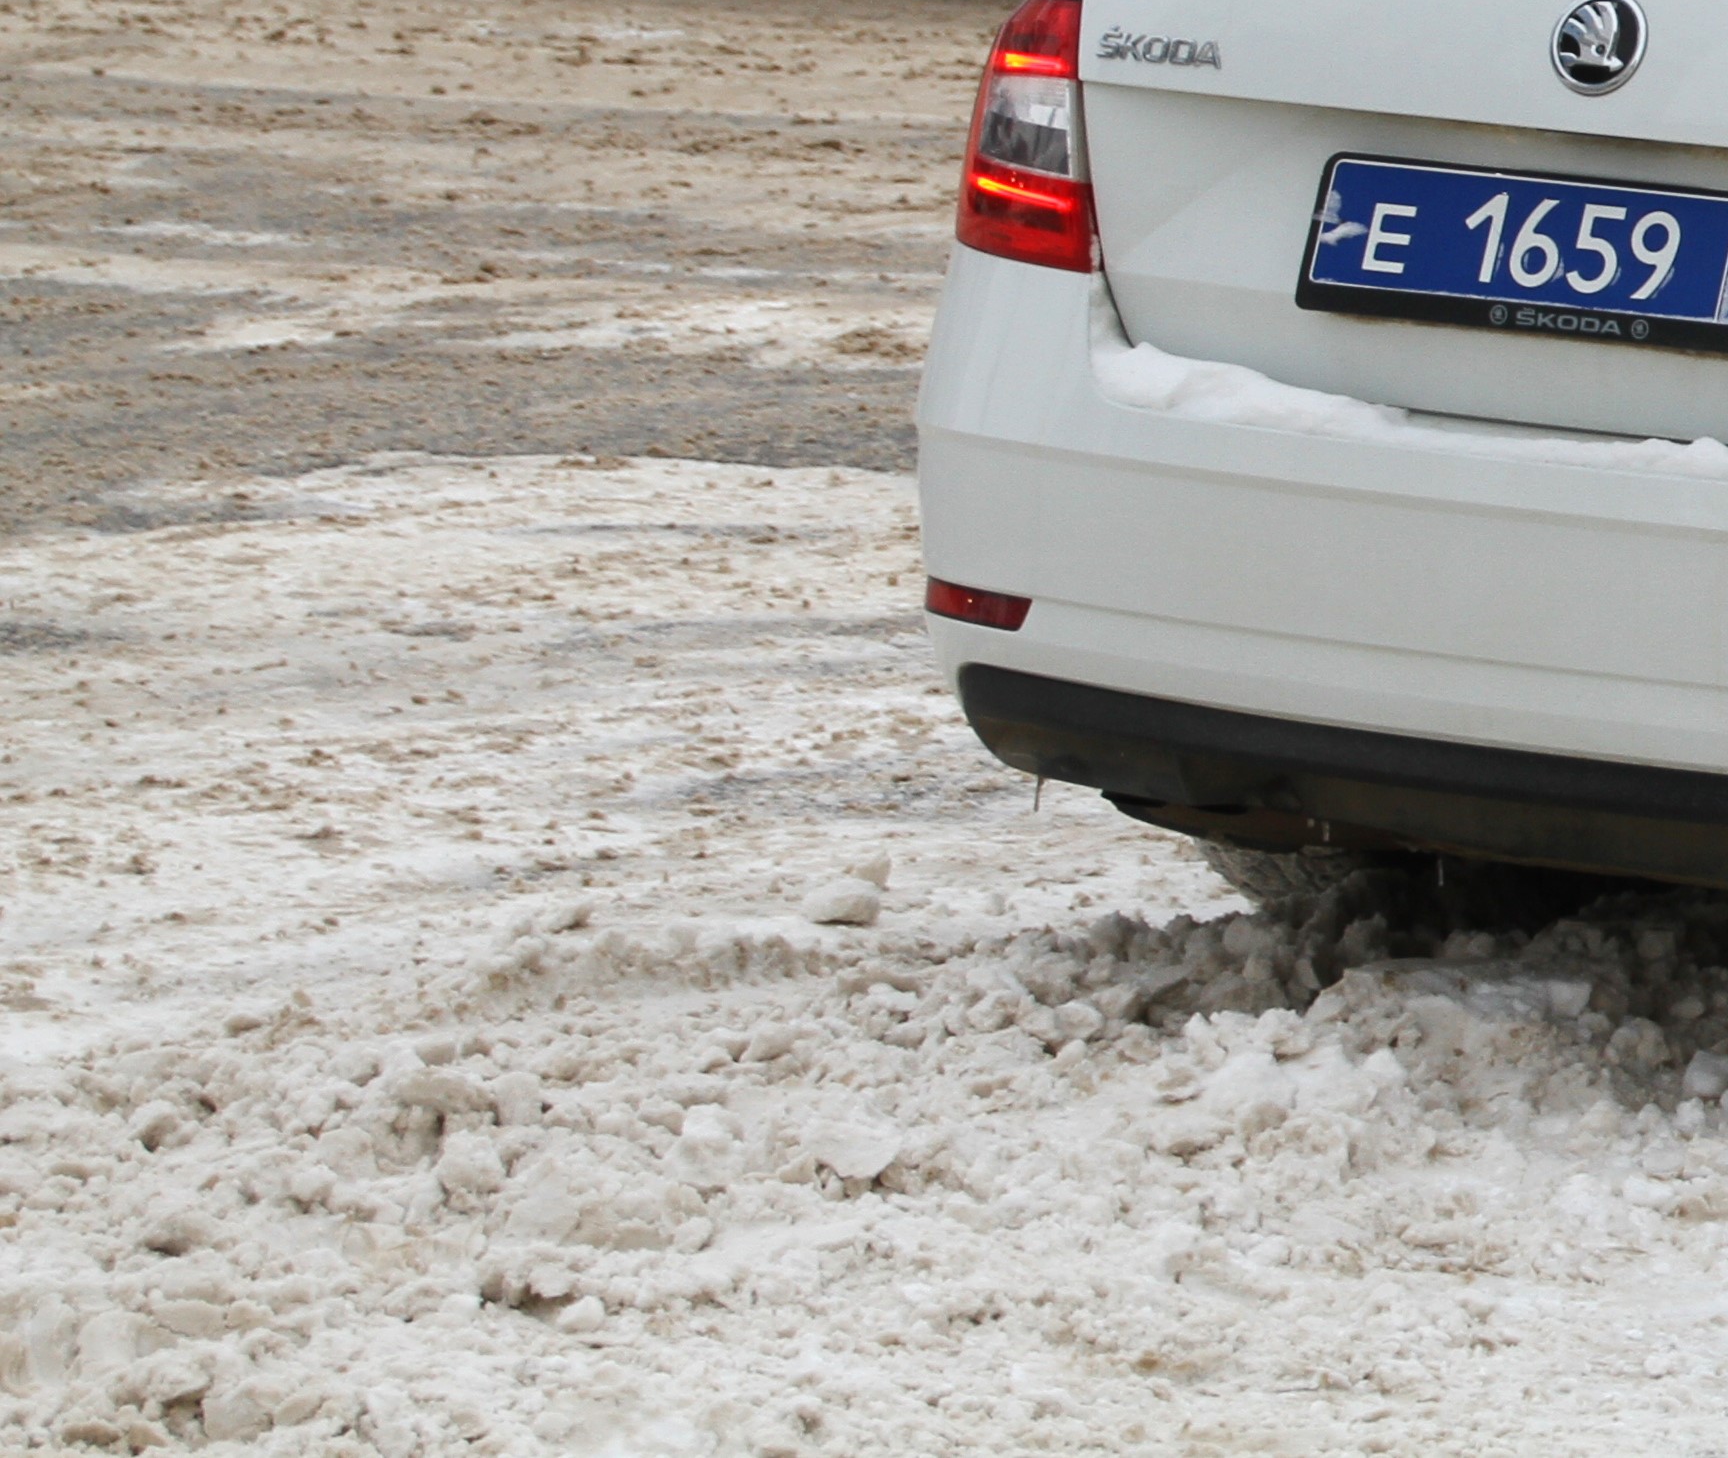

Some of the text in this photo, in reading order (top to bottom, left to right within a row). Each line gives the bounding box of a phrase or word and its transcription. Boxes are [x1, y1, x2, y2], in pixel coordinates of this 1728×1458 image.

[1096, 25, 1222, 70] ŠKODA
[1361, 202, 1417, 274] Е
[1465, 192, 1682, 300] 1659
[1515, 307, 1621, 336] ŠKODA
